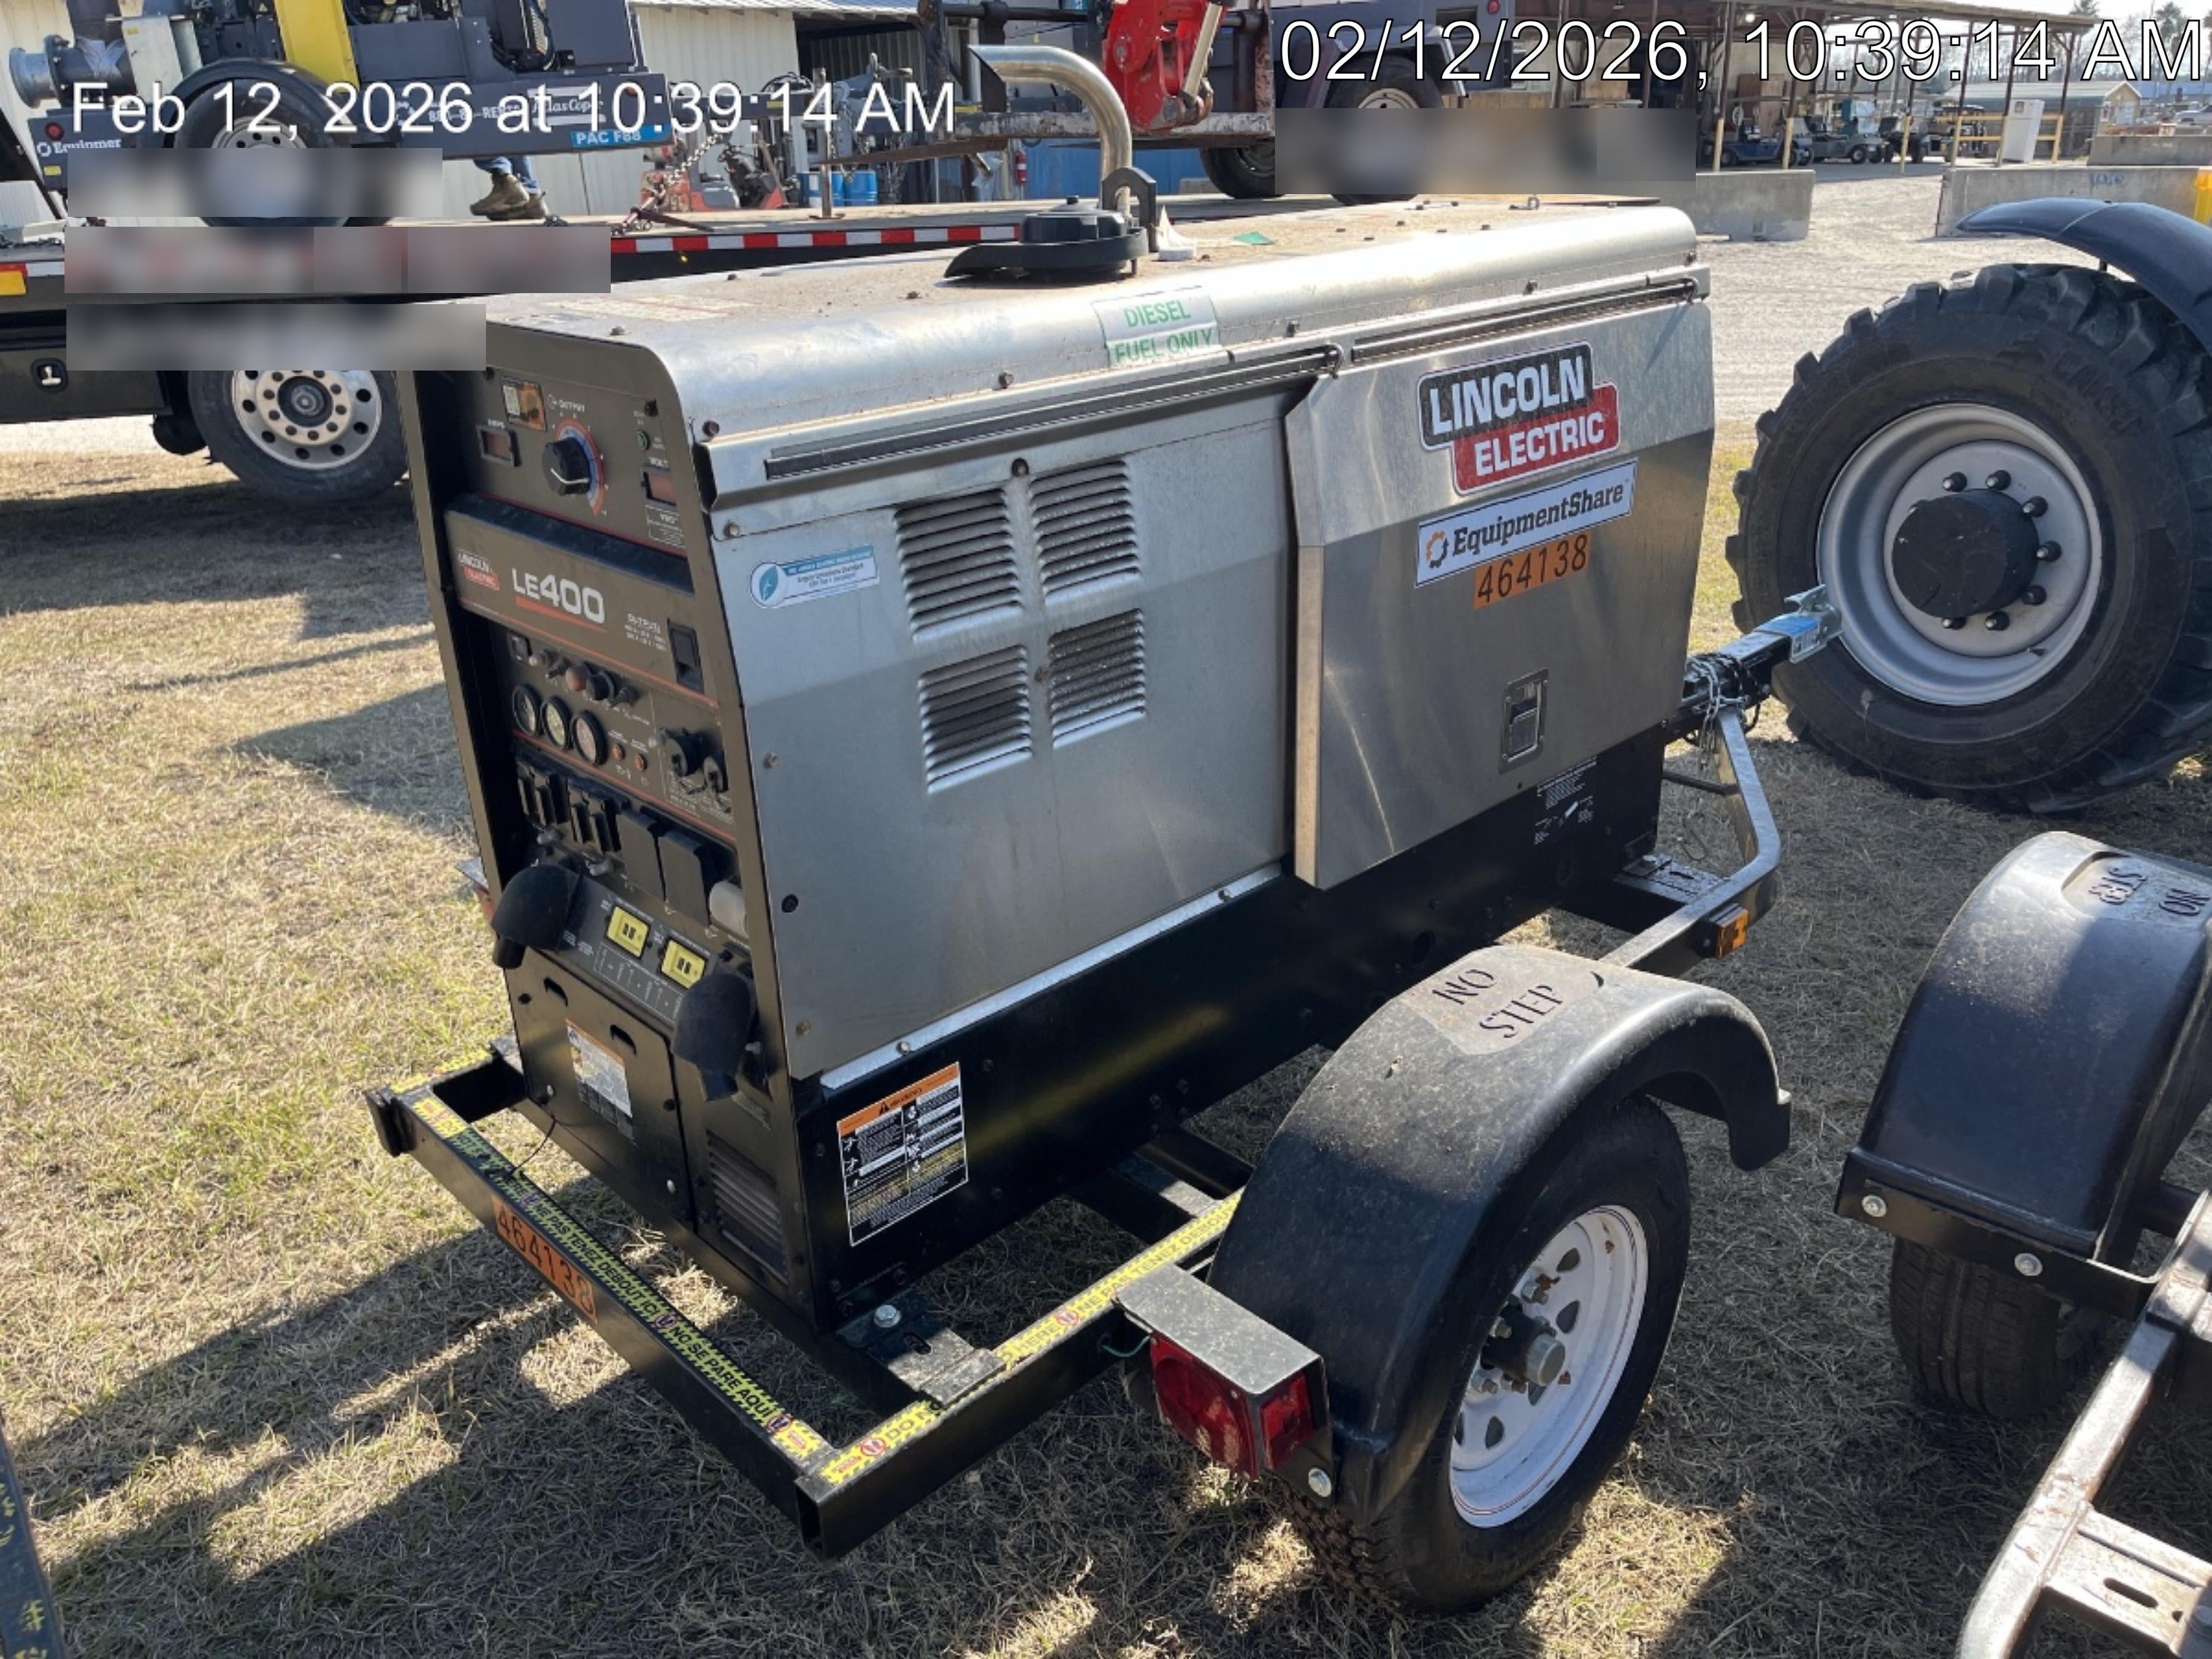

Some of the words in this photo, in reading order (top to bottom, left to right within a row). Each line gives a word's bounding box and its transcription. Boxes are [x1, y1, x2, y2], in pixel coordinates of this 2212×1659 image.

[576, 131, 609, 145] PAC
[1124, 299, 1191, 327] DIESEL
[1114, 339, 1163, 364] FUEL
[1167, 327, 1212, 353] ONLY
[1430, 355, 1586, 436] LINCOLN
[1475, 411, 1605, 477] ELECTRIC
[1452, 484, 1623, 557] EquipmentShare
[512, 567, 605, 625] LE400
[1477, 533, 1588, 604] 464138
[1432, 968, 1497, 1005] NO
[1478, 985, 1564, 1039] STEP
[498, 1205, 598, 1316] 464138
[568, 1233, 604, 1263] TENEZ
[598, 1261, 645, 1300] DEBOUT
[669, 1326, 692, 1344] NO
[687, 1342, 708, 1360] SE
[704, 1358, 741, 1390] PARE
[885, 1417, 915, 1441] DO
